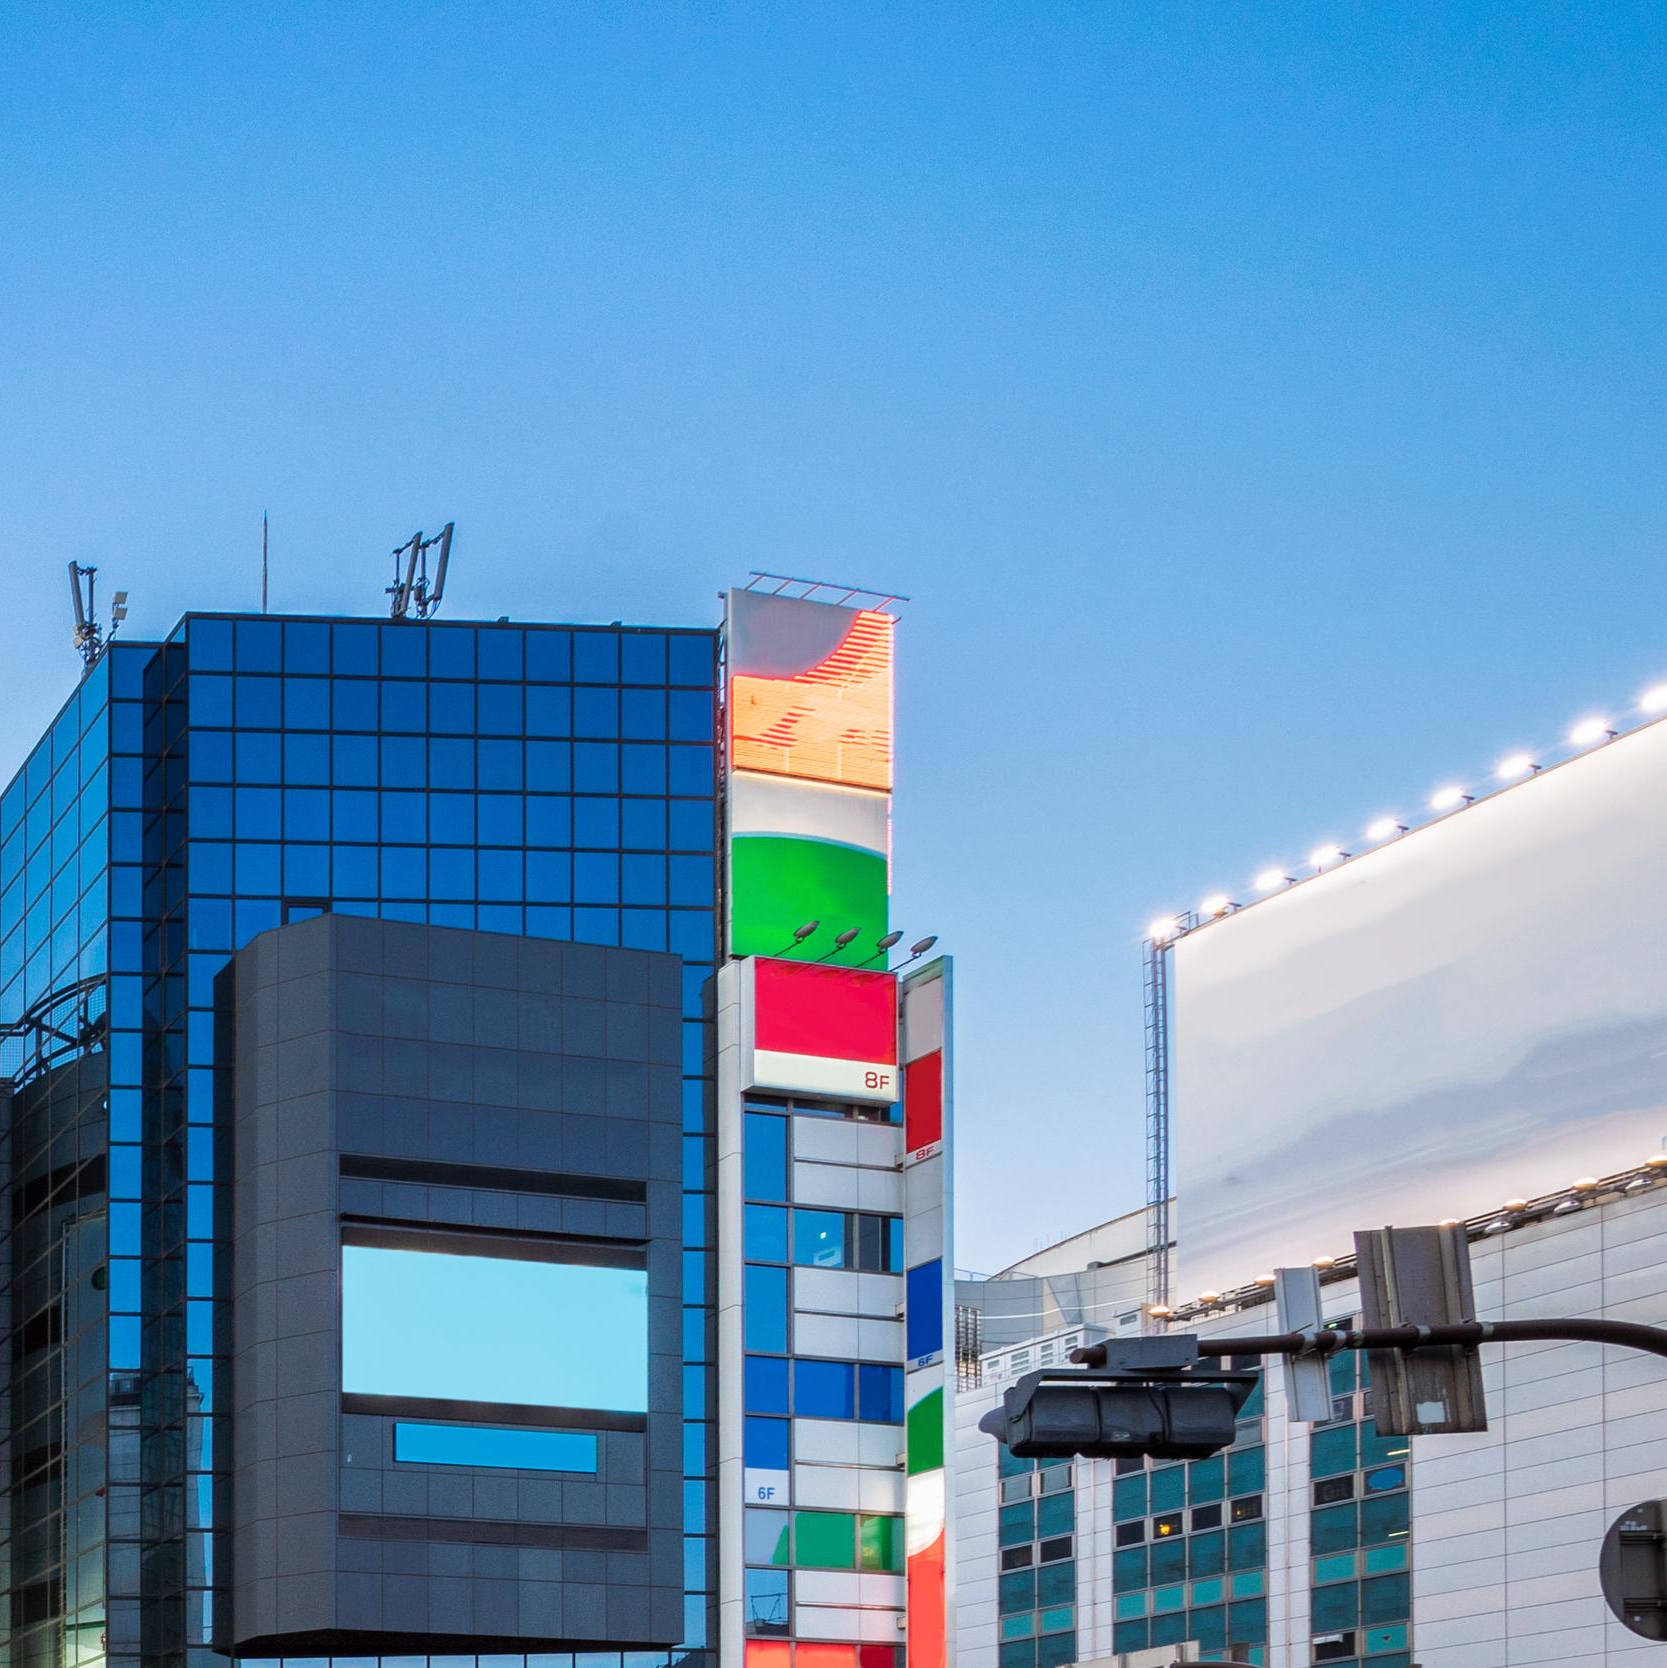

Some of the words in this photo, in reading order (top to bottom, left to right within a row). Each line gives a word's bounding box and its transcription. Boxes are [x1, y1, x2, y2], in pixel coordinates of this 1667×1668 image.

[865, 1071, 890, 1090] 8F
[915, 1145, 935, 1160] 8F
[917, 1354, 934, 1367] 6F
[757, 1486, 775, 1500] 6F
